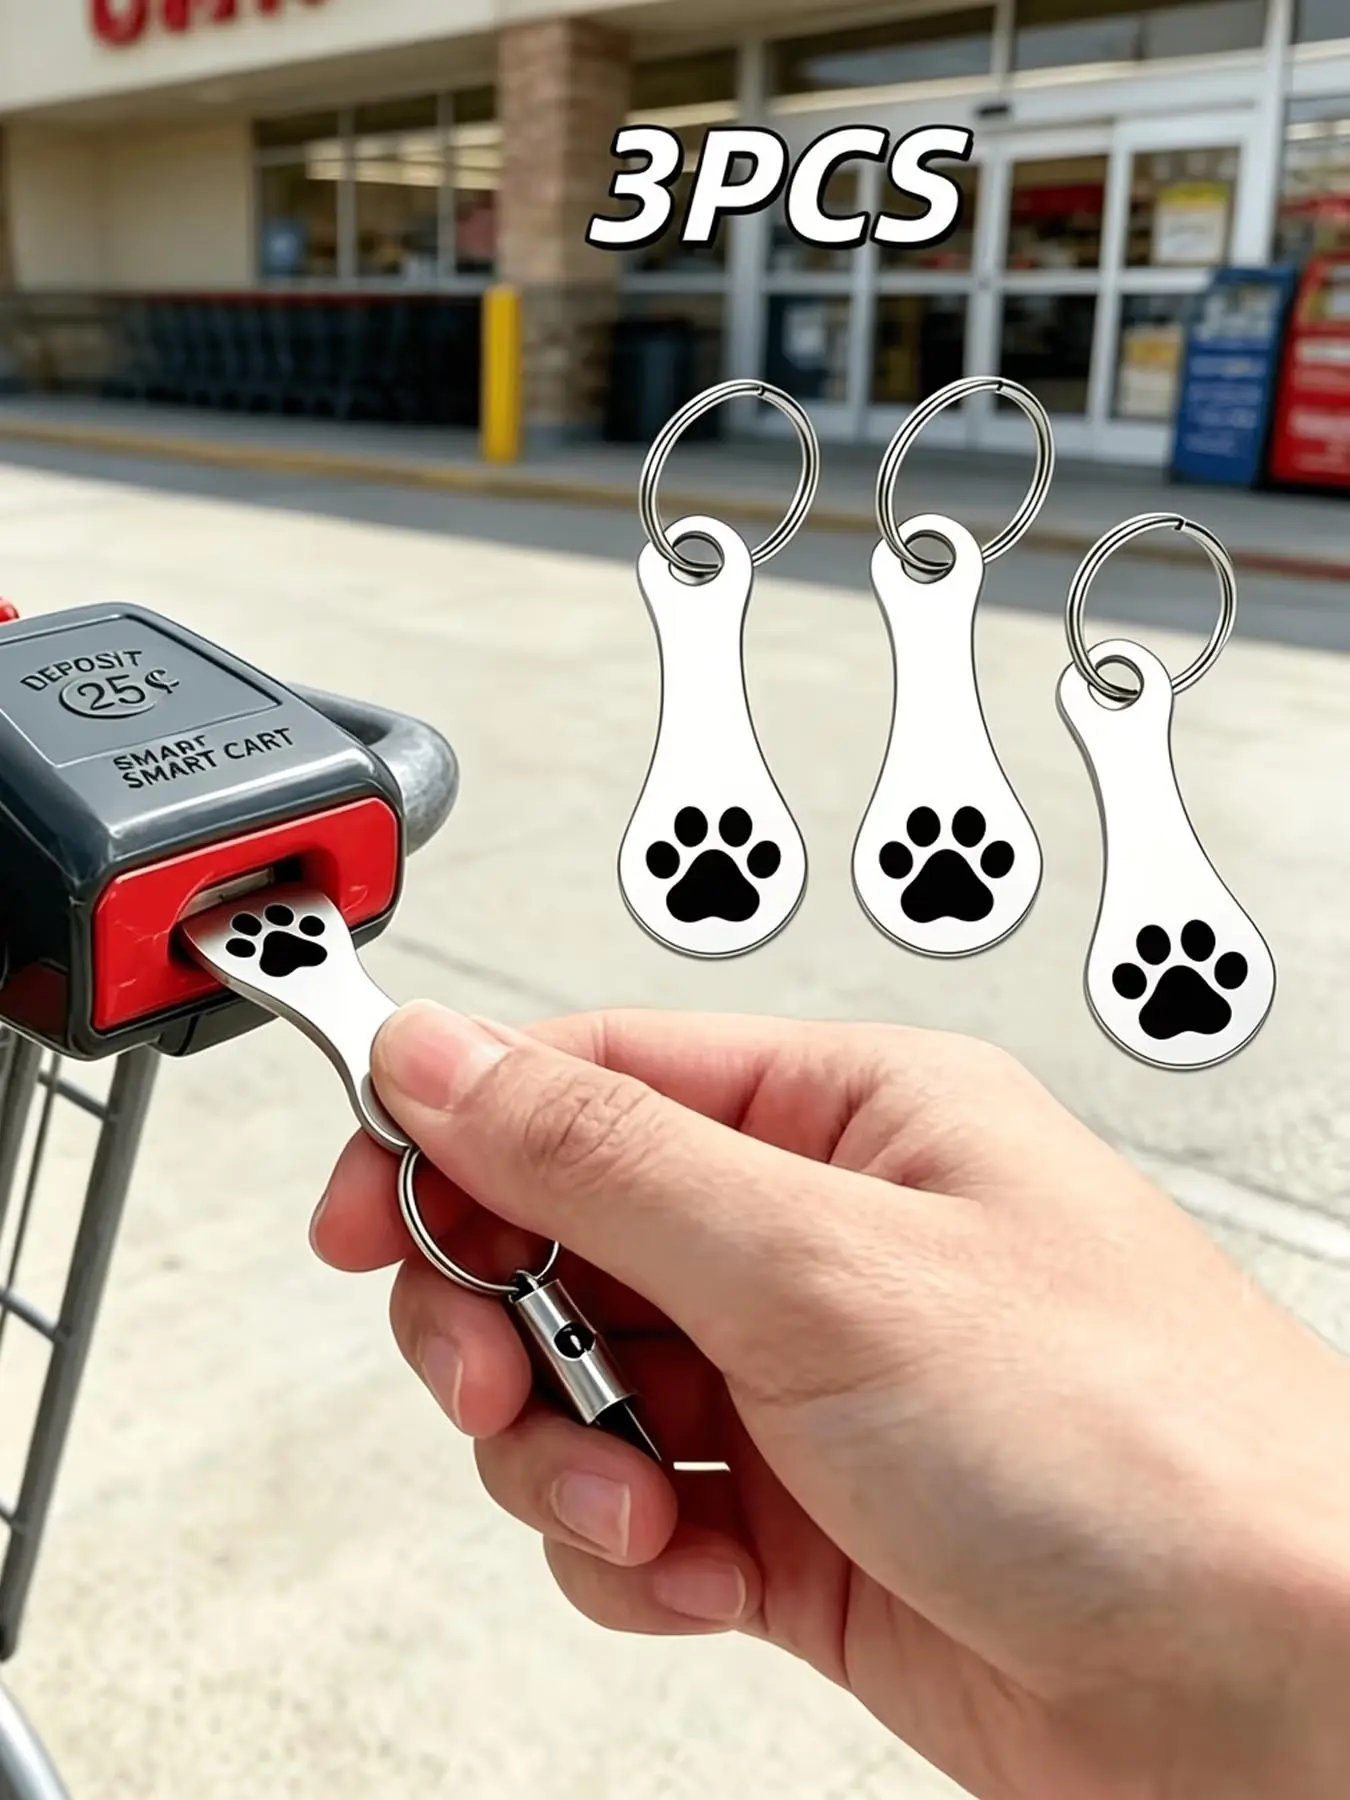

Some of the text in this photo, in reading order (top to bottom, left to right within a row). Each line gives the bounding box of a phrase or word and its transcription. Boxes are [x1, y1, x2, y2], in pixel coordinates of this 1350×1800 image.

[20, 650, 142, 692] DEPOSIT
[122, 728, 294, 789] SMART CART
